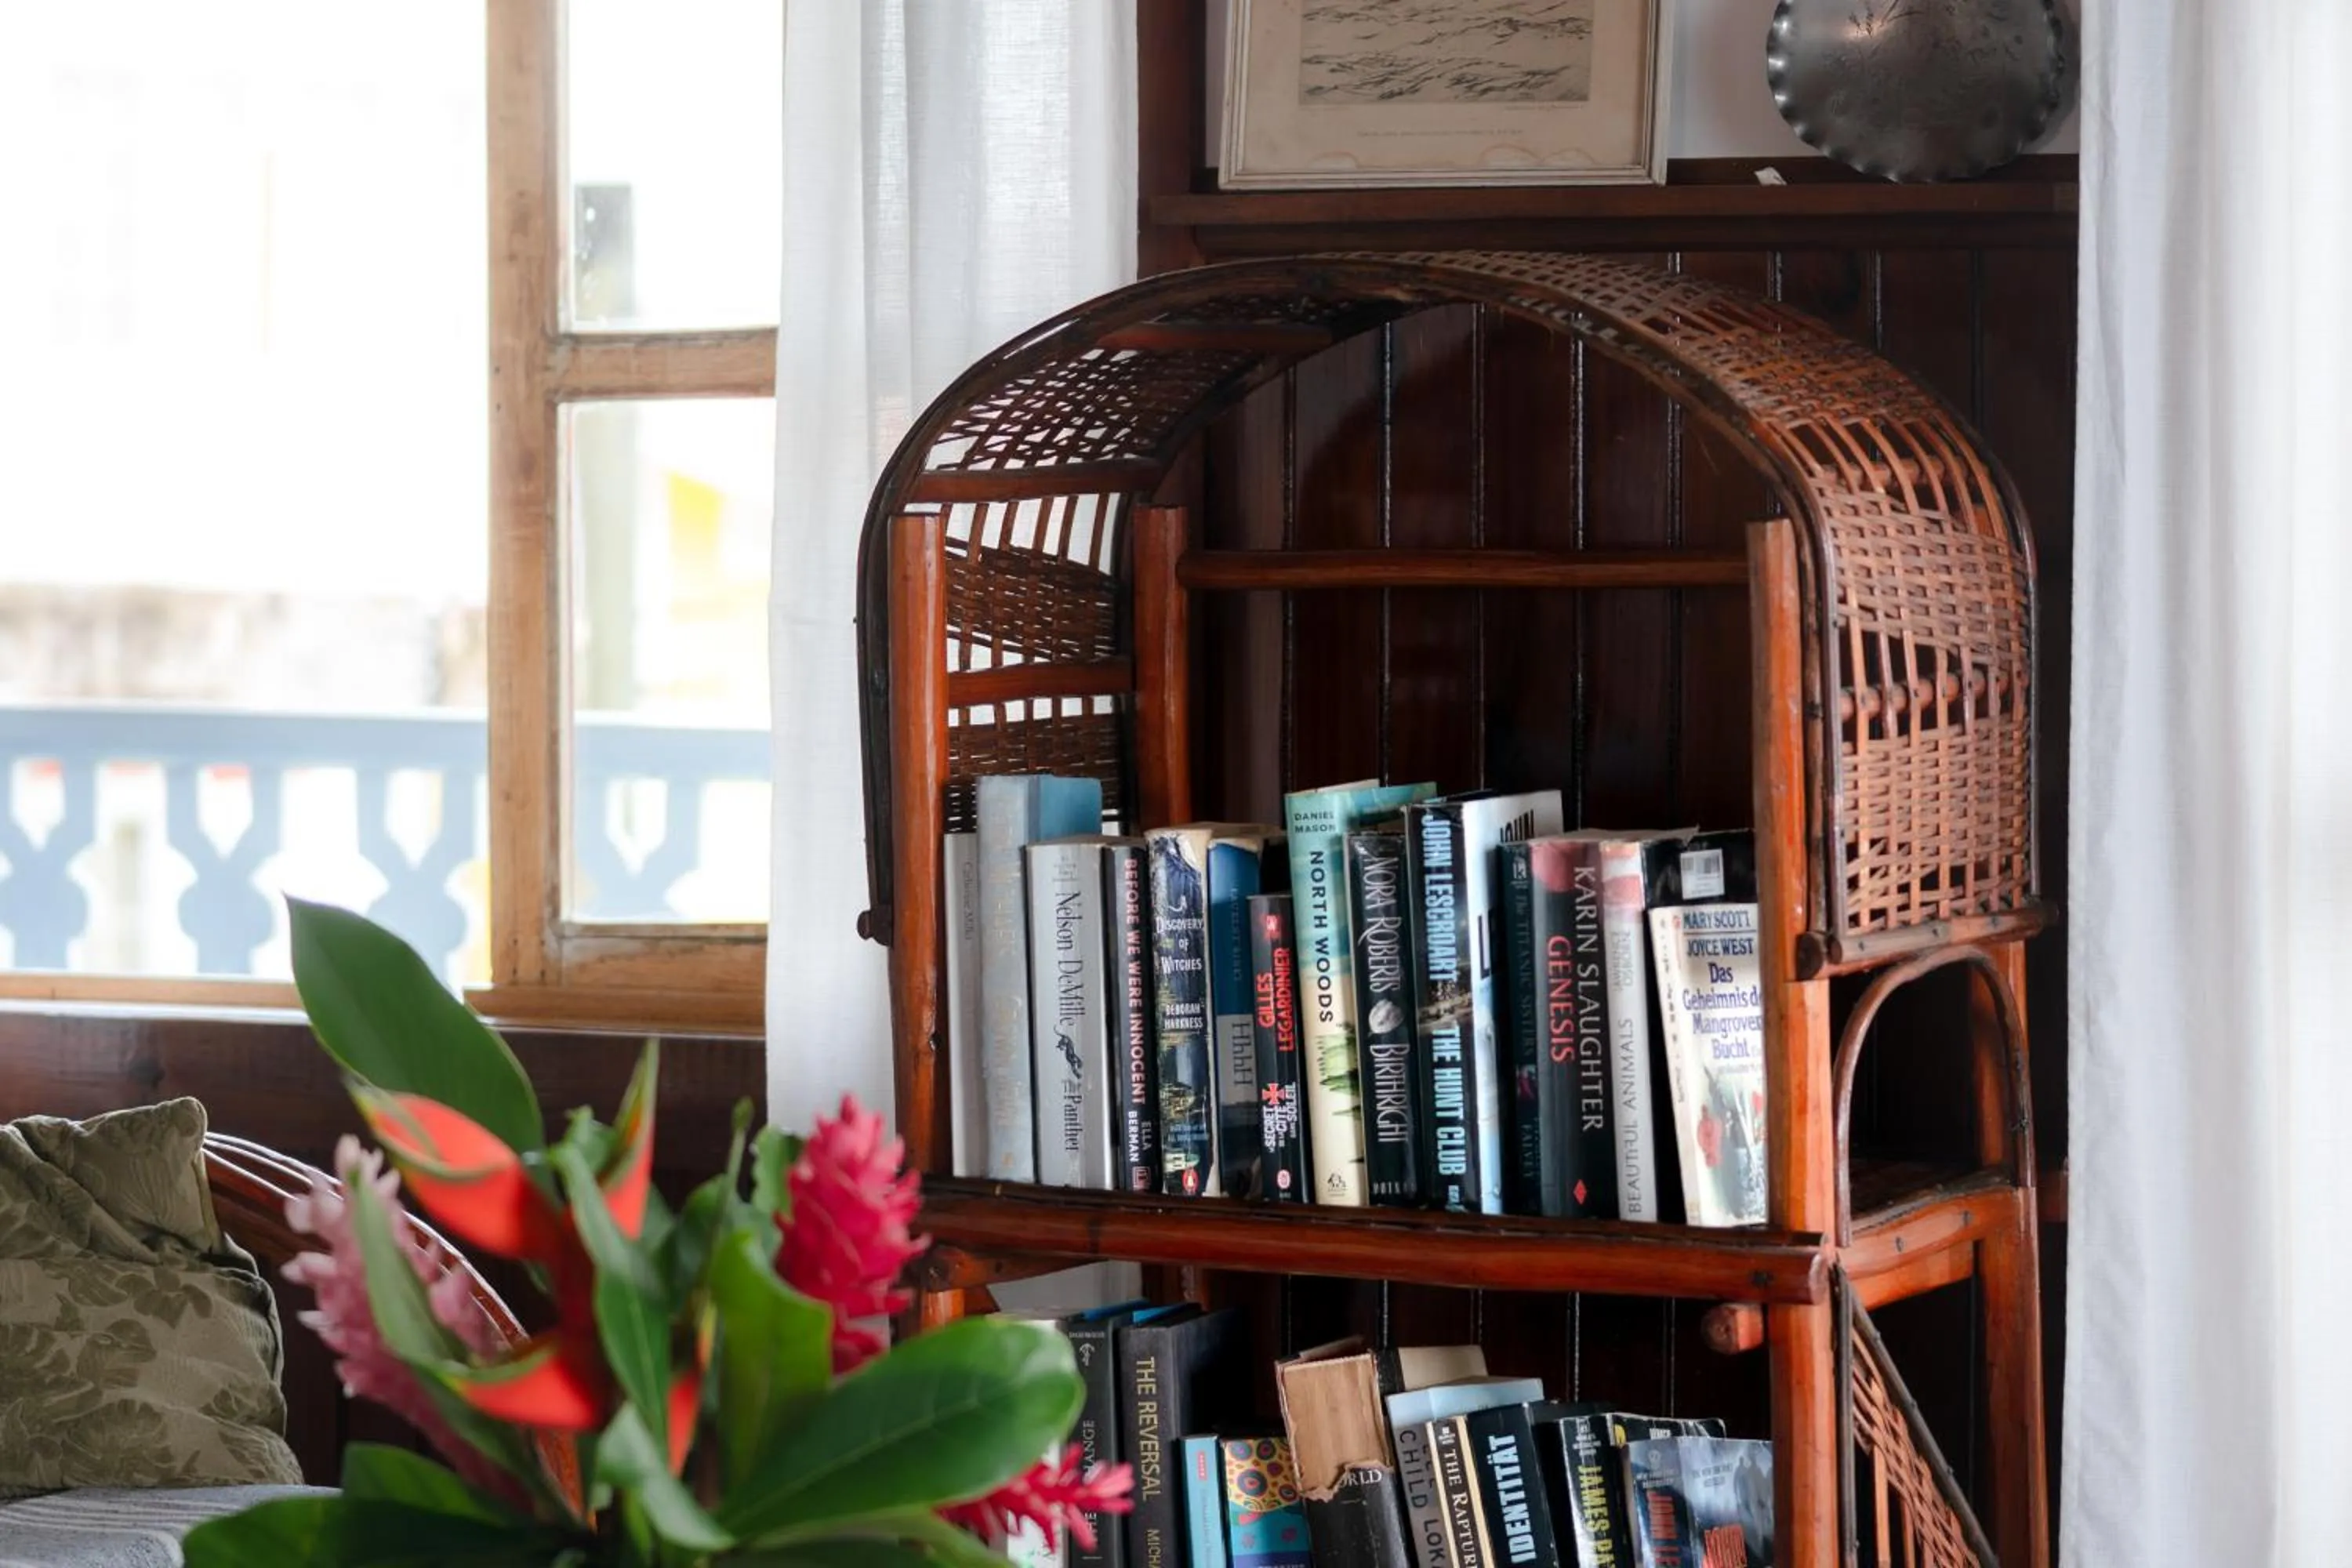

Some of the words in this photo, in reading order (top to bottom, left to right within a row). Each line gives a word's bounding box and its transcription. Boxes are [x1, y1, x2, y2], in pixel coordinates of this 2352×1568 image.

[1294, 811, 1334, 821] DANIEL
[1295, 824, 1336, 833] MASON
[1421, 812, 1451, 867] JOHN
[1124, 858, 1139, 924] BEFORE
[1309, 851, 1328, 927] NORTH
[1364, 855, 1398, 911] NORA
[1573, 866, 1597, 953] KARIN
[1055, 891, 1083, 951] Nelson
[1127, 930, 1141, 955] WE
[1425, 873, 1458, 982] LESCROART
[1713, 910, 1750, 927] SCOTT
[1357, 916, 1401, 993] ROBERTS
[1687, 939, 1719, 956] JOYCE
[1720, 938, 1753, 955] WEST
[1708, 962, 1733, 983] Das
[1058, 960, 1086, 1026] DeMille
[1127, 960, 1142, 1008] WERE
[1256, 971, 1275, 1028] GILLES
[1273, 947, 1295, 1052] LEGARDINIER
[1316, 938, 1334, 1023] WOODS
[1548, 935, 1574, 1063] GENESIS
[1682, 987, 1748, 1011] Geheimnis
[1164, 1018, 1203, 1030] HARKNESS
[1166, 1003, 1200, 1015] DEBORAH
[1131, 1013, 1146, 1104] INNOCENT
[1432, 1023, 1461, 1063] THE
[1576, 963, 1603, 1131] SLAUGHTER
[1618, 1018, 1635, 1110] ANIMALS
[1711, 1037, 1750, 1059] Bucht
[1284, 1081, 1298, 1122] SOLEIL
[1370, 1044, 1409, 1144] BIRTHRIGHT
[1433, 1067, 1464, 1119] HUNT
[1065, 1095, 1083, 1152] Panther
[1128, 1110, 1139, 1162] BERMAN
[1142, 1121, 1152, 1151] ELLA
[1263, 1105, 1276, 1148] SECRET
[1436, 1124, 1466, 1175] CLUB
[1620, 1121, 1642, 1214] BEAUTIFUL
[1136, 1356, 1156, 1395] THE
[1138, 1401, 1161, 1501] REVERSAL
[1399, 1430, 1428, 1508] CHILD
[1443, 1449, 1462, 1486] THE
[1486, 1435, 1537, 1563] IDENTITÄT
[1577, 1465, 1610, 1533] JAMES
[1424, 1519, 1446, 1568] LOK
